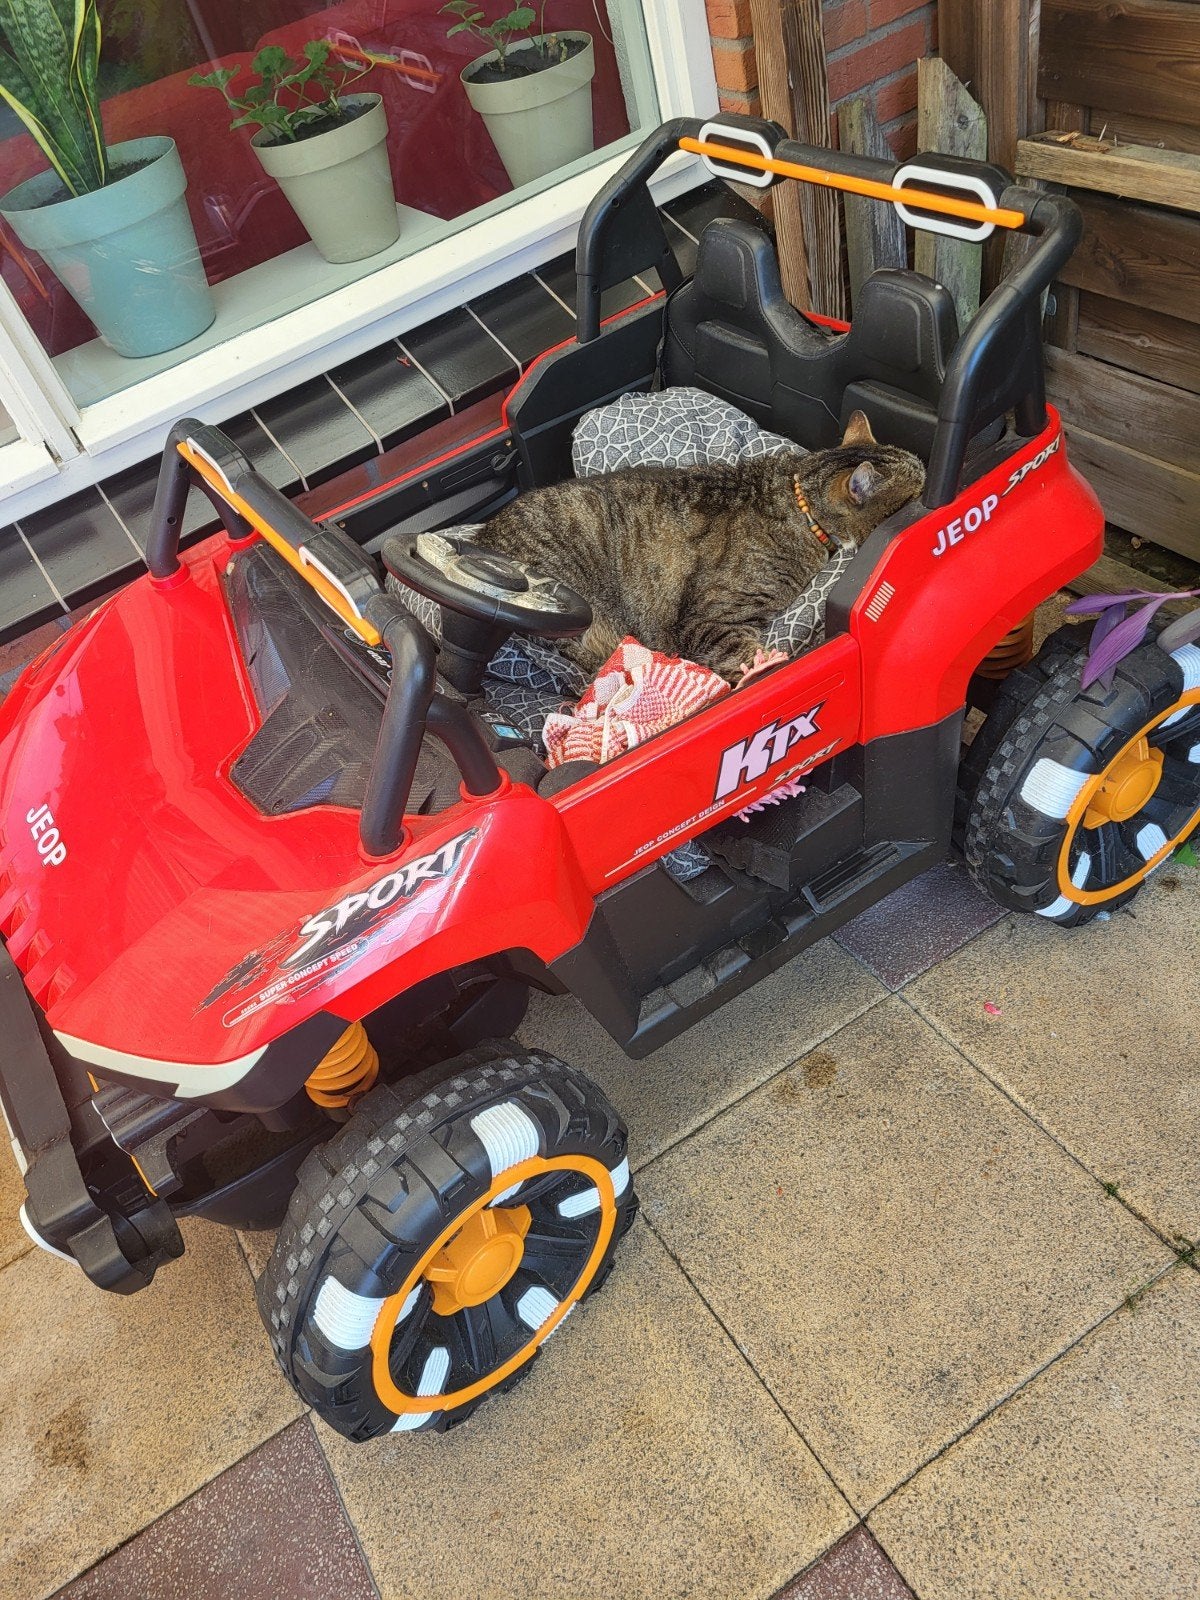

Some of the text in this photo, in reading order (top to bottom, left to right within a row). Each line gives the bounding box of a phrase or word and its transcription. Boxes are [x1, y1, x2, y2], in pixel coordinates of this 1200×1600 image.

[932, 433, 1061, 556] JEOP SPORT
[766, 738, 843, 791] SPORT
[26, 803, 67, 867] JEOP
[633, 800, 725, 856] JEOP CONCEPT DEIGN
[281, 828, 478, 969] SPORT
[259, 943, 358, 1001] SUPER CONCEPT SPEED
